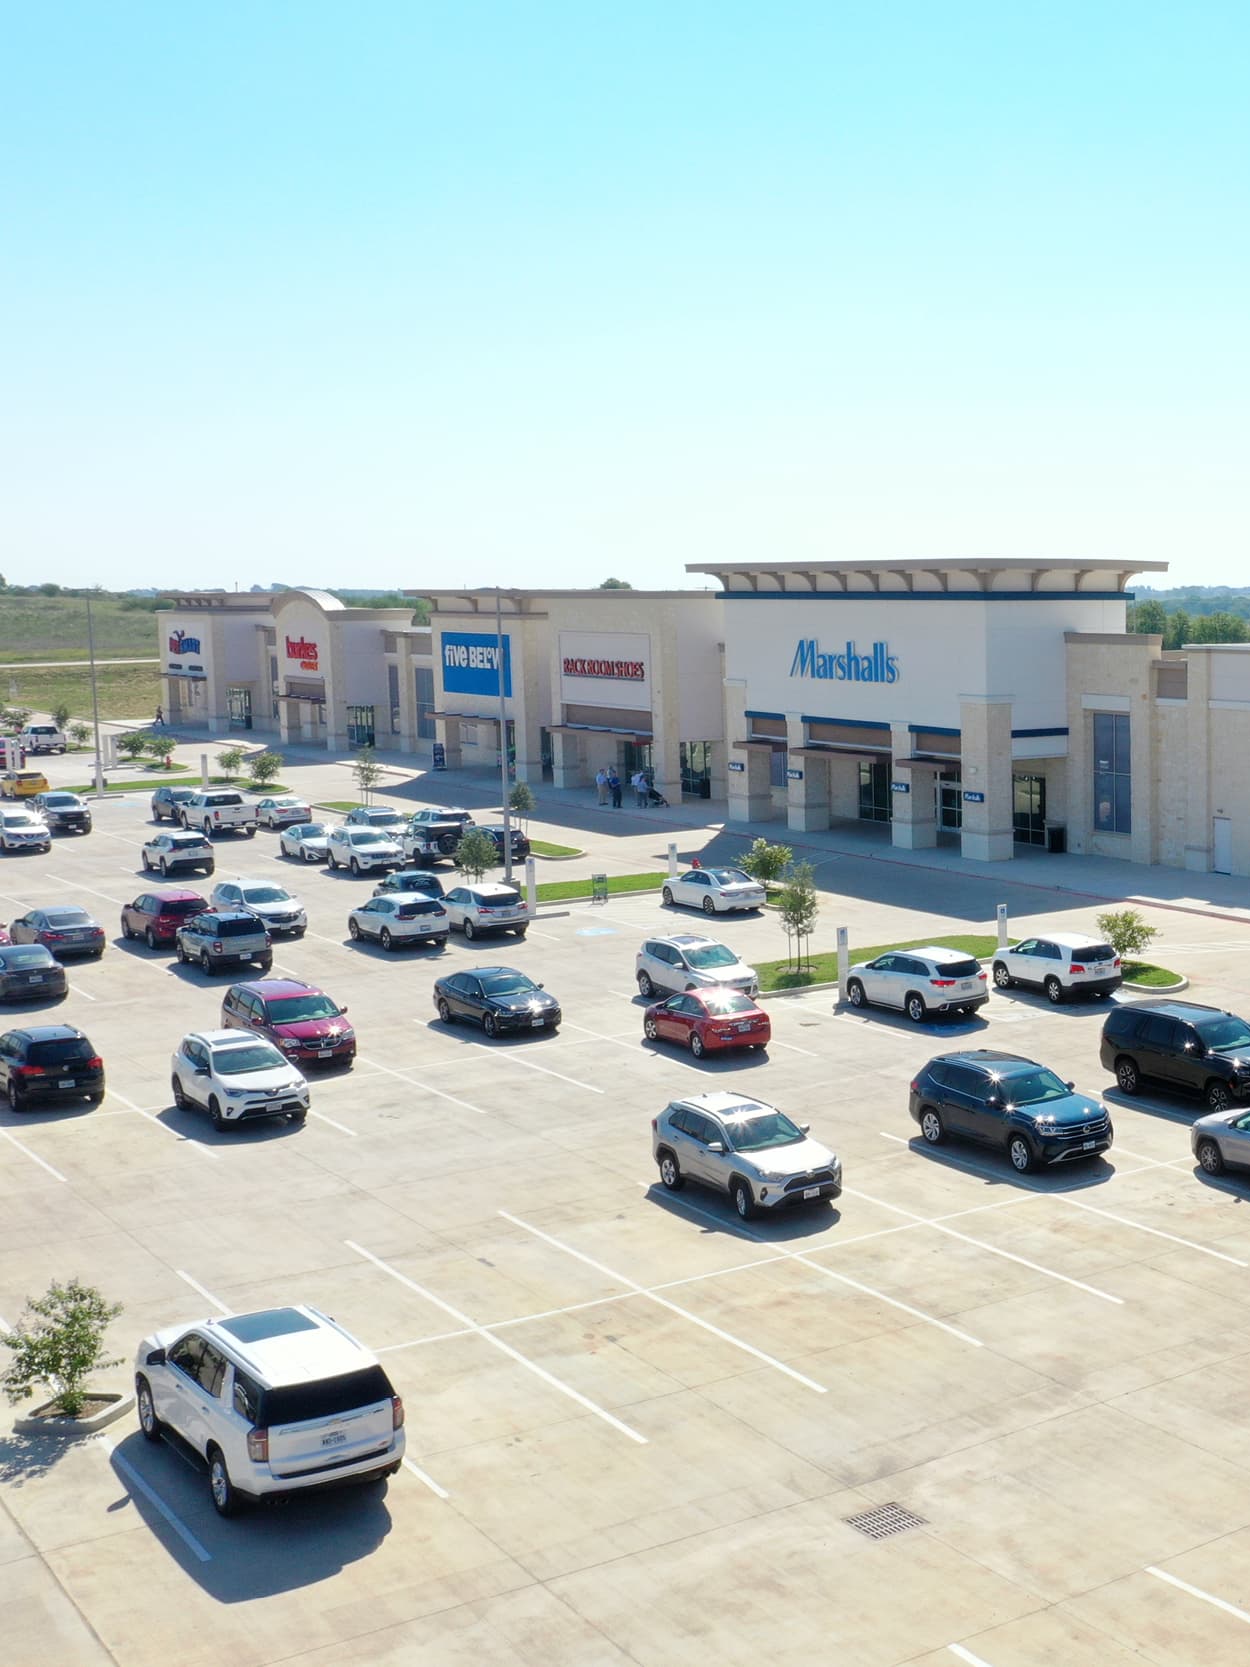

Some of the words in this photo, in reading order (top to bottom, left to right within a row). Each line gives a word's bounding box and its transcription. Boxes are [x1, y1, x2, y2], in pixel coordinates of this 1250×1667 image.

[563, 657, 587, 675] RACK
[587, 659, 614, 677] ROOM
[614, 660, 645, 679] SHOES
[789, 638, 898, 684] Marshalls
